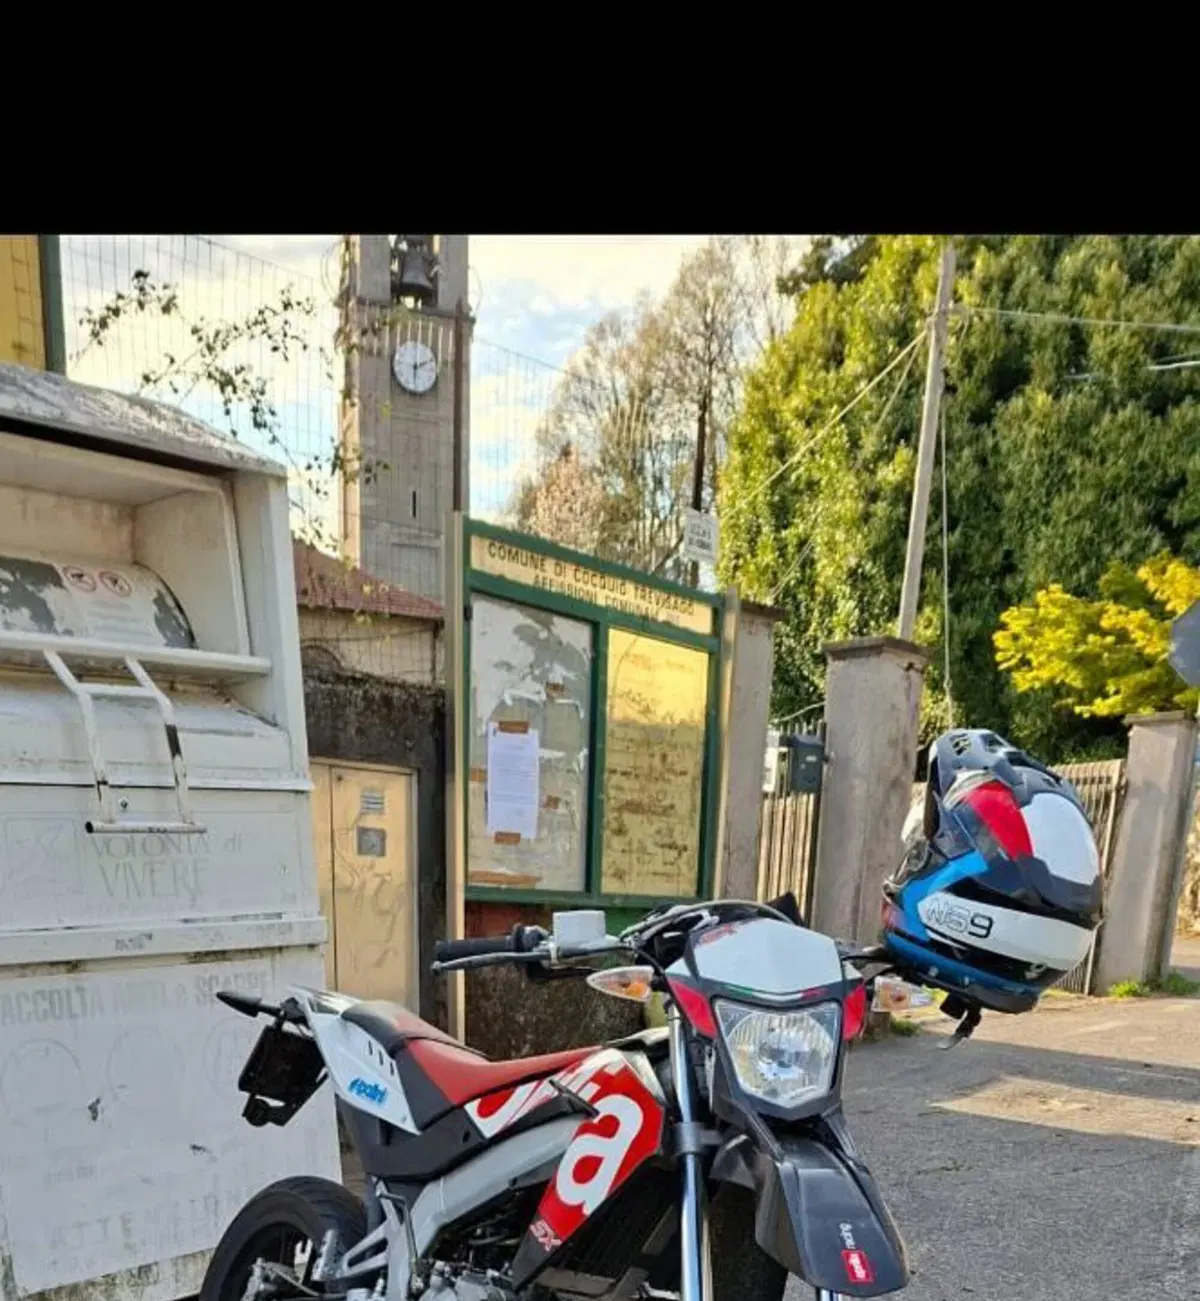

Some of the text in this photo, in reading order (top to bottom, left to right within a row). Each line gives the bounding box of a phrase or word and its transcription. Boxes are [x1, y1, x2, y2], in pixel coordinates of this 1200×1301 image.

[487, 540, 547, 572] COMUNE
[554, 561, 567, 577] DI
[529, 1218, 563, 1252] SX
